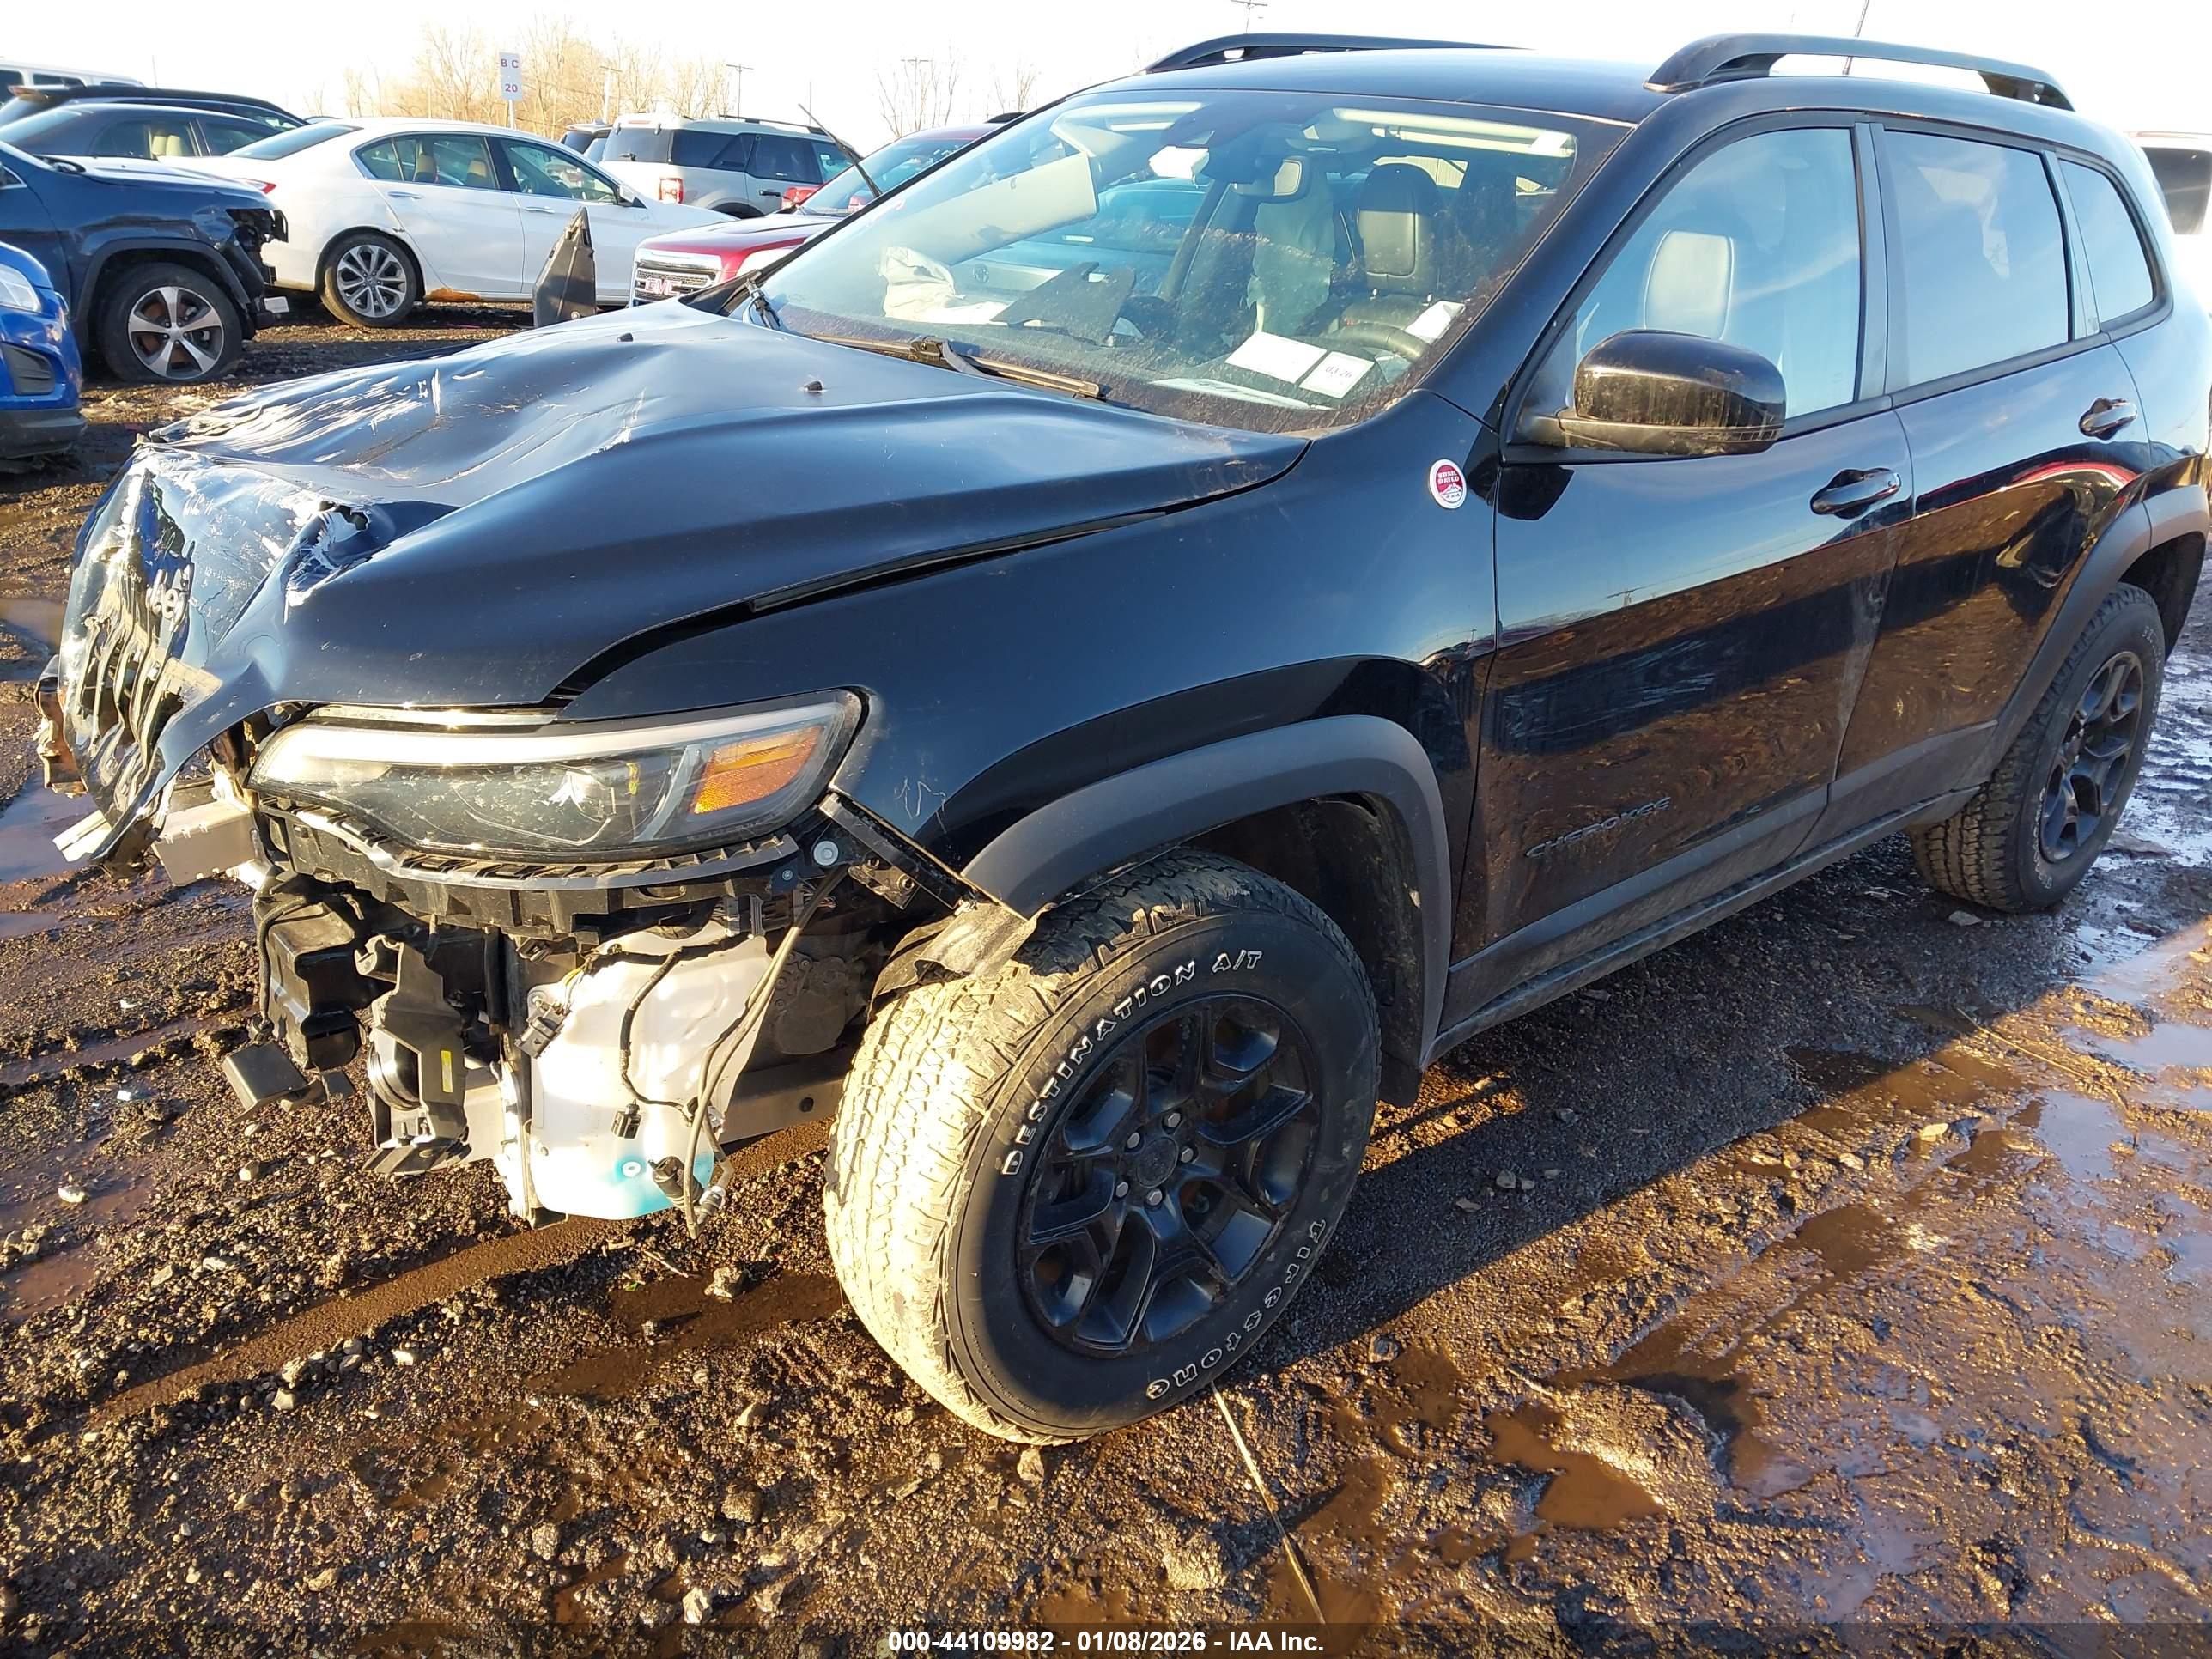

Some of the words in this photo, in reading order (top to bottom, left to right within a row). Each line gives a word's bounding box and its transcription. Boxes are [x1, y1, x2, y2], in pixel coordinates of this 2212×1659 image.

[501, 58, 507, 67] B
[512, 59, 519, 68] C
[505, 83, 518, 93] 20
[644, 277, 682, 296] GMC
[1525, 796, 1671, 858] CHEROKEE
[1000, 960, 1195, 1176] DESTINATION
[1212, 950, 1262, 973] A/T
